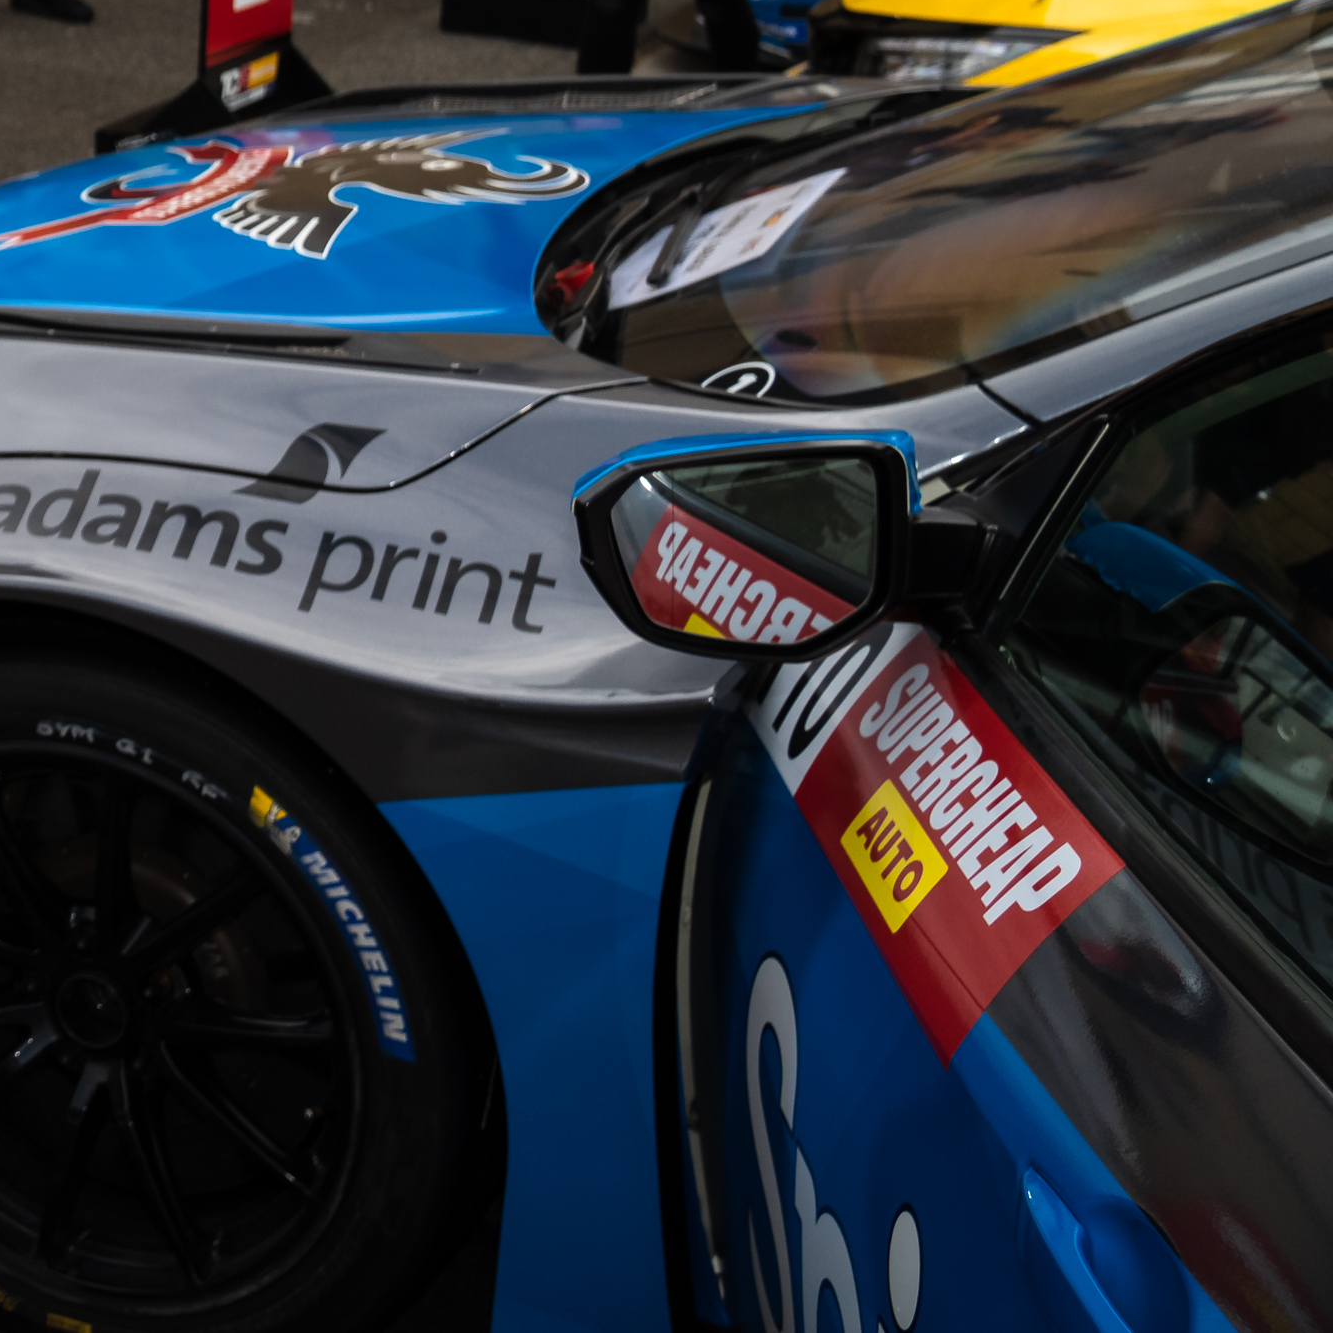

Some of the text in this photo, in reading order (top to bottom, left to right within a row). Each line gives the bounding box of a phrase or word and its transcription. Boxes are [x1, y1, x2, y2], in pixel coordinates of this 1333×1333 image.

[298, 528, 556, 634] print
[856, 807, 924, 903] AUTO
[859, 664, 1082, 926] SUPERCHEAP
[301, 850, 409, 1044] MICHELIN
